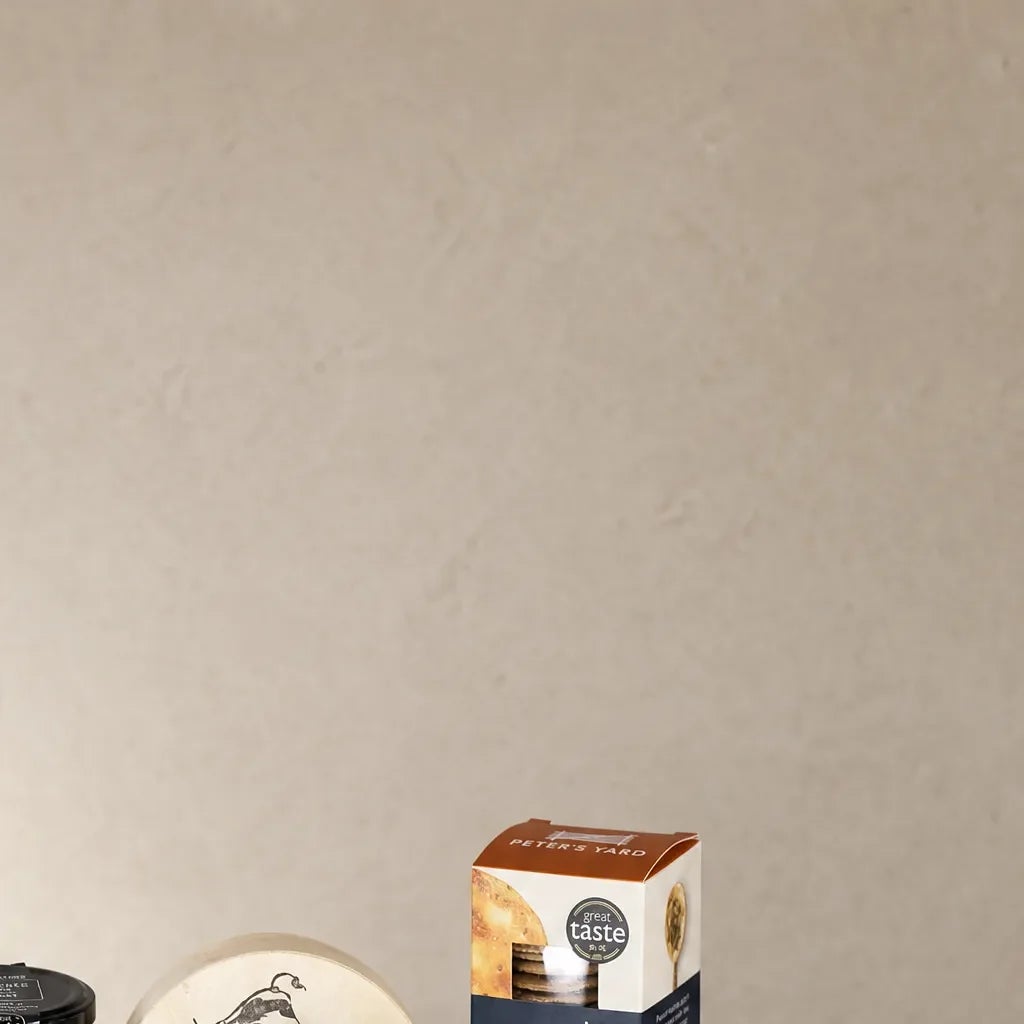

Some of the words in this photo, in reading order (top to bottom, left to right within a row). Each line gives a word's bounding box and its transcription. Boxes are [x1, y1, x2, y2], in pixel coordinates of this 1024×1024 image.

[509, 838, 587, 852] PETER'S
[594, 846, 647, 857] YARD
[583, 912, 611, 924] great
[570, 921, 626, 943] taste
